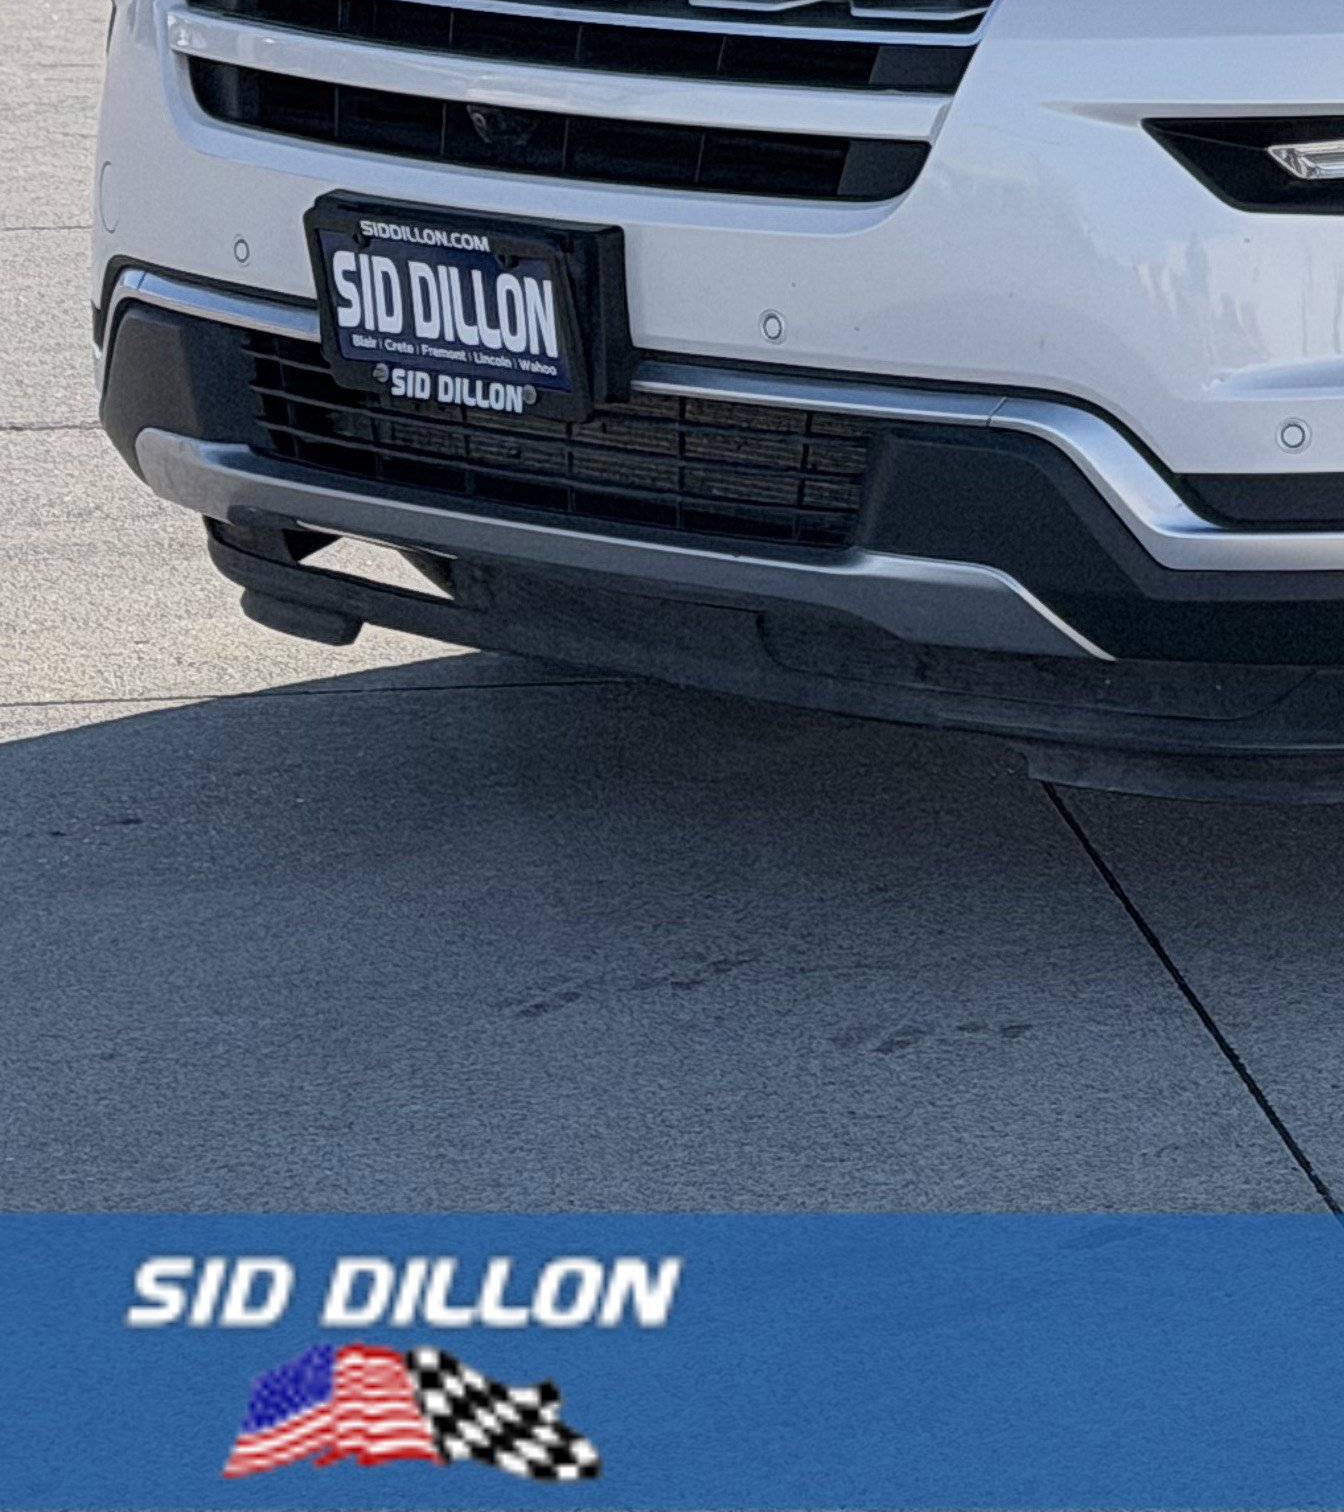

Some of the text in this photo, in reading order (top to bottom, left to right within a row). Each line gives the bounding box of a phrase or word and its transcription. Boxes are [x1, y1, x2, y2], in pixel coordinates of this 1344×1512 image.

[360, 220, 489, 252] SIDDILLON.COM
[333, 251, 559, 358] SID DILLON
[352, 334, 557, 377] Blair Crete Fremont Lincoln Wahoo
[390, 368, 523, 414] SID DILLON
